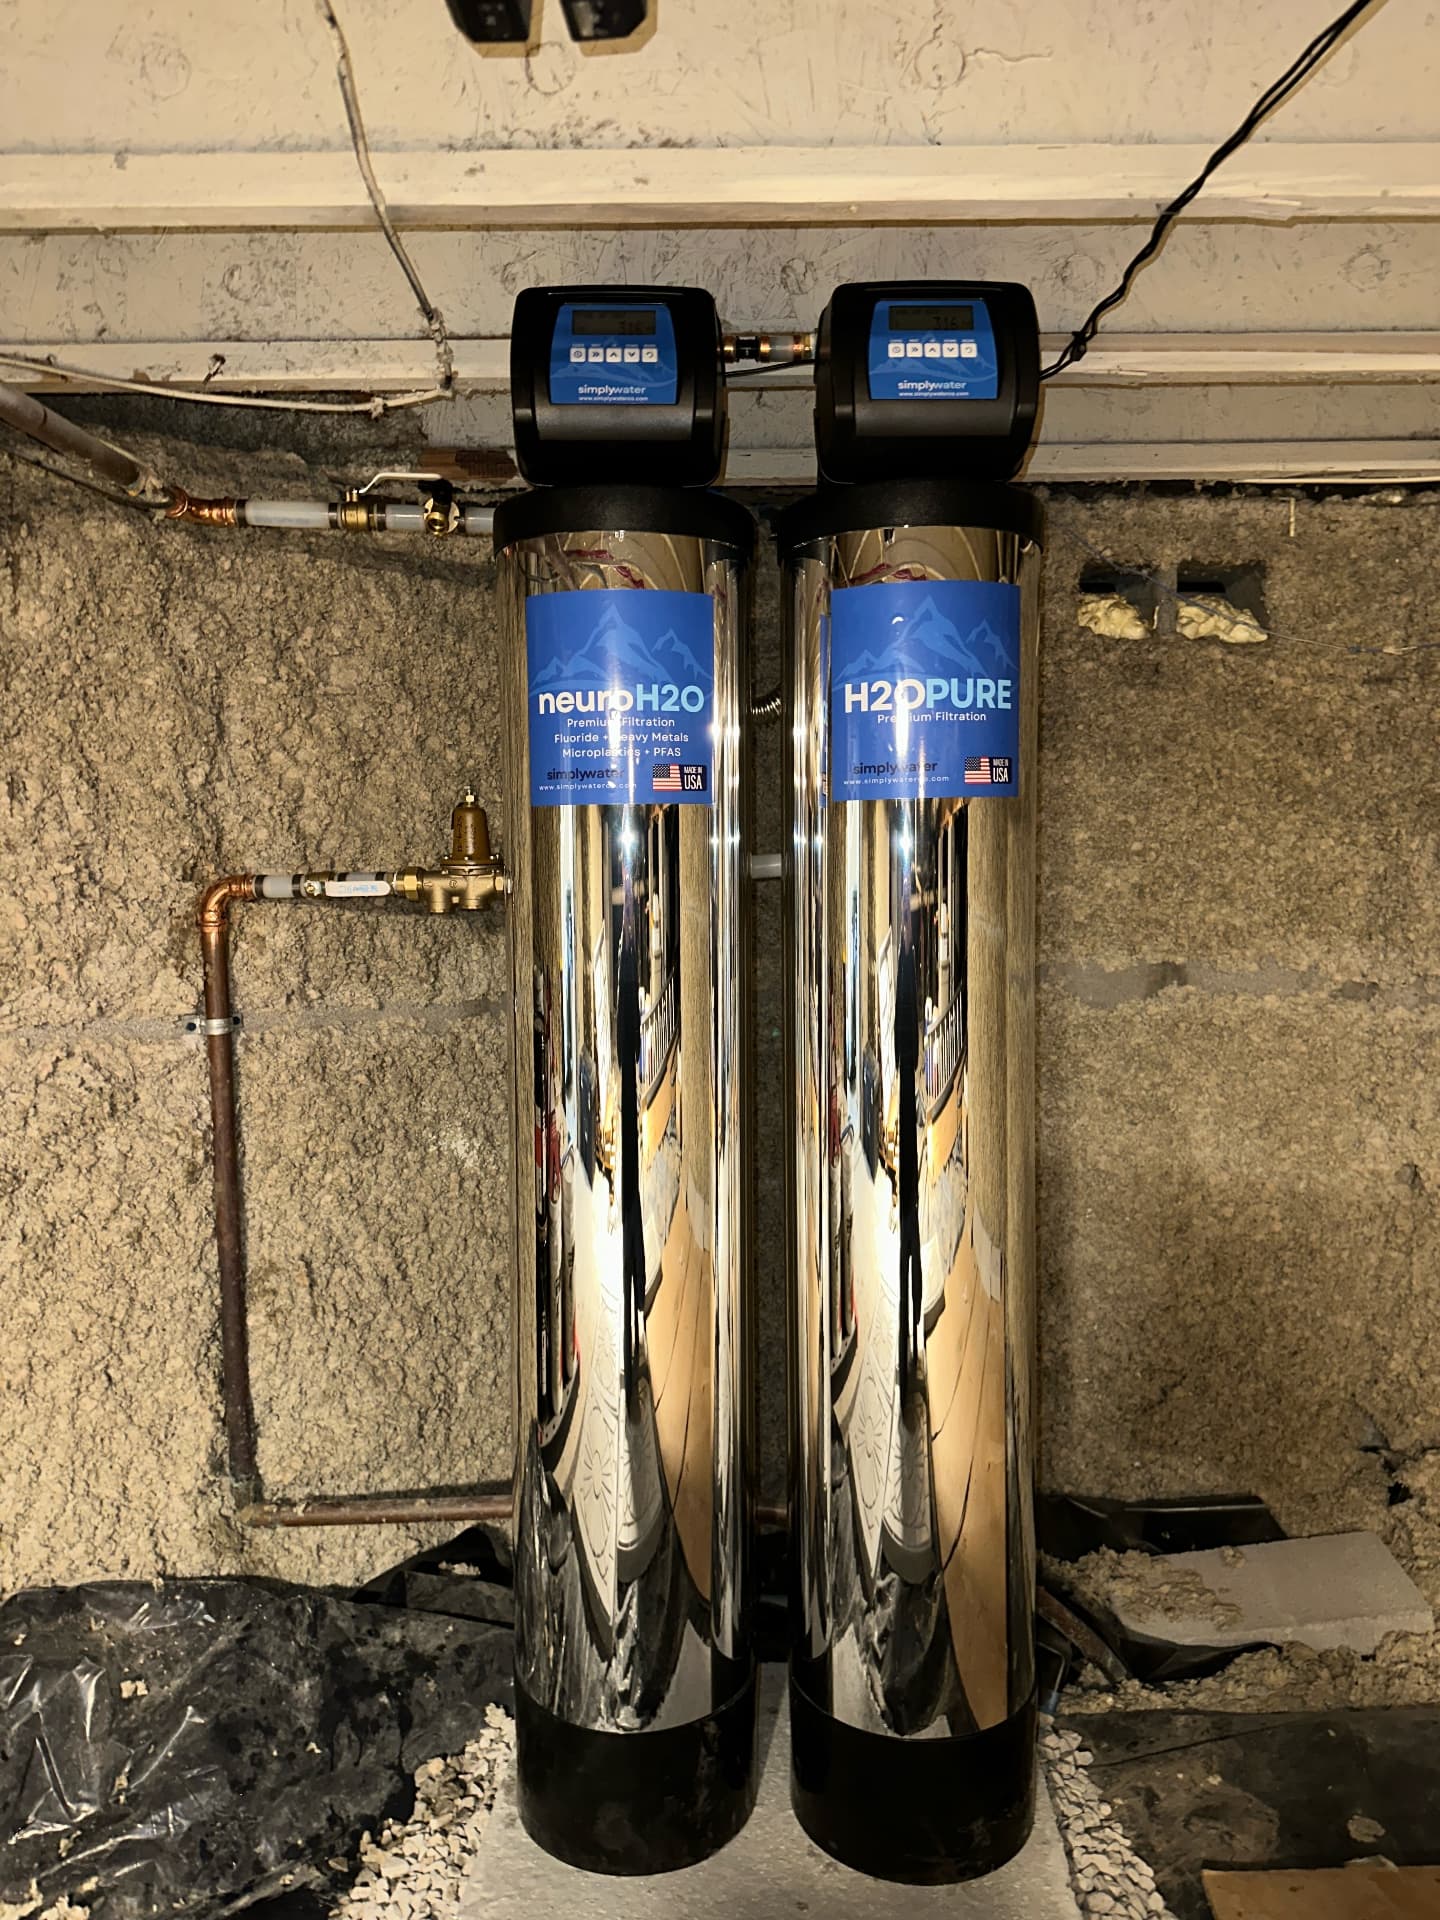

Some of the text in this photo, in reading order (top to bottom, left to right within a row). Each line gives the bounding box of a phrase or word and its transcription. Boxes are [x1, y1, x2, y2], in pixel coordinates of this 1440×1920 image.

[578, 384, 646, 396] simplywater
[897, 380, 967, 391] simplywater
[845, 678, 1012, 714] H2OPURE
[567, 717, 676, 728] Premiu Filtration
[877, 711, 987, 724] Preium Filtration
[554, 733, 599, 743] Fluoride
[611, 732, 648, 744] eavy
[652, 731, 689, 742] Metals
[653, 747, 681, 757] PFAS
[683, 766, 697, 774] MADE
[993, 767, 1009, 783] USA
[684, 774, 703, 790] USA
